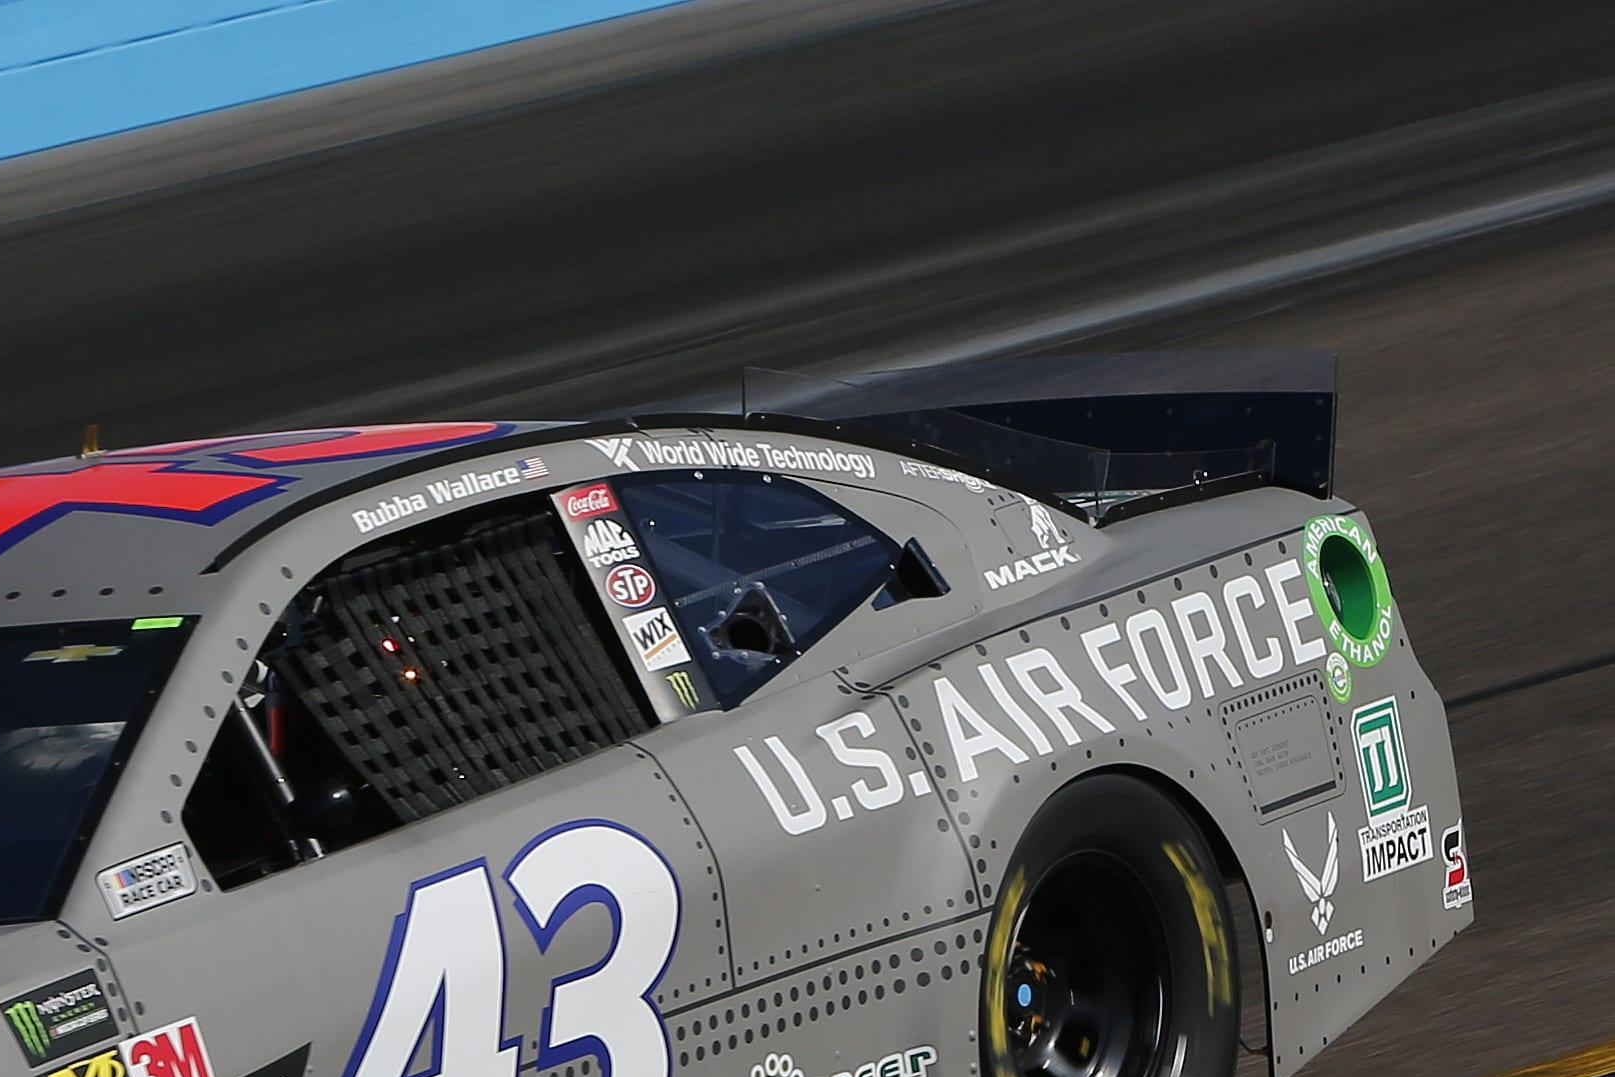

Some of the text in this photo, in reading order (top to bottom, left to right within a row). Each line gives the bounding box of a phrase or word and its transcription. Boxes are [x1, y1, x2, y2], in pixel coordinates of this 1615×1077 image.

[636, 440, 876, 478] World Wide Technology
[352, 466, 521, 534] Bubba Wallace
[584, 519, 635, 557] MAC
[589, 545, 640, 568] TOOLS
[1306, 516, 1377, 579] AMERICAN
[613, 569, 648, 601] STP
[984, 545, 1080, 590] MACK
[633, 611, 673, 650] WIX
[1329, 605, 1391, 663] ETHANOL
[734, 557, 1326, 836] U.S. AIR FORCE
[1361, 810, 1428, 845] TRANSPORTATION
[1365, 828, 1428, 876] IMPACT
[121, 876, 184, 905] RACE CAR
[1308, 945, 1325, 967] AIR
[1325, 929, 1364, 959] FORCE
